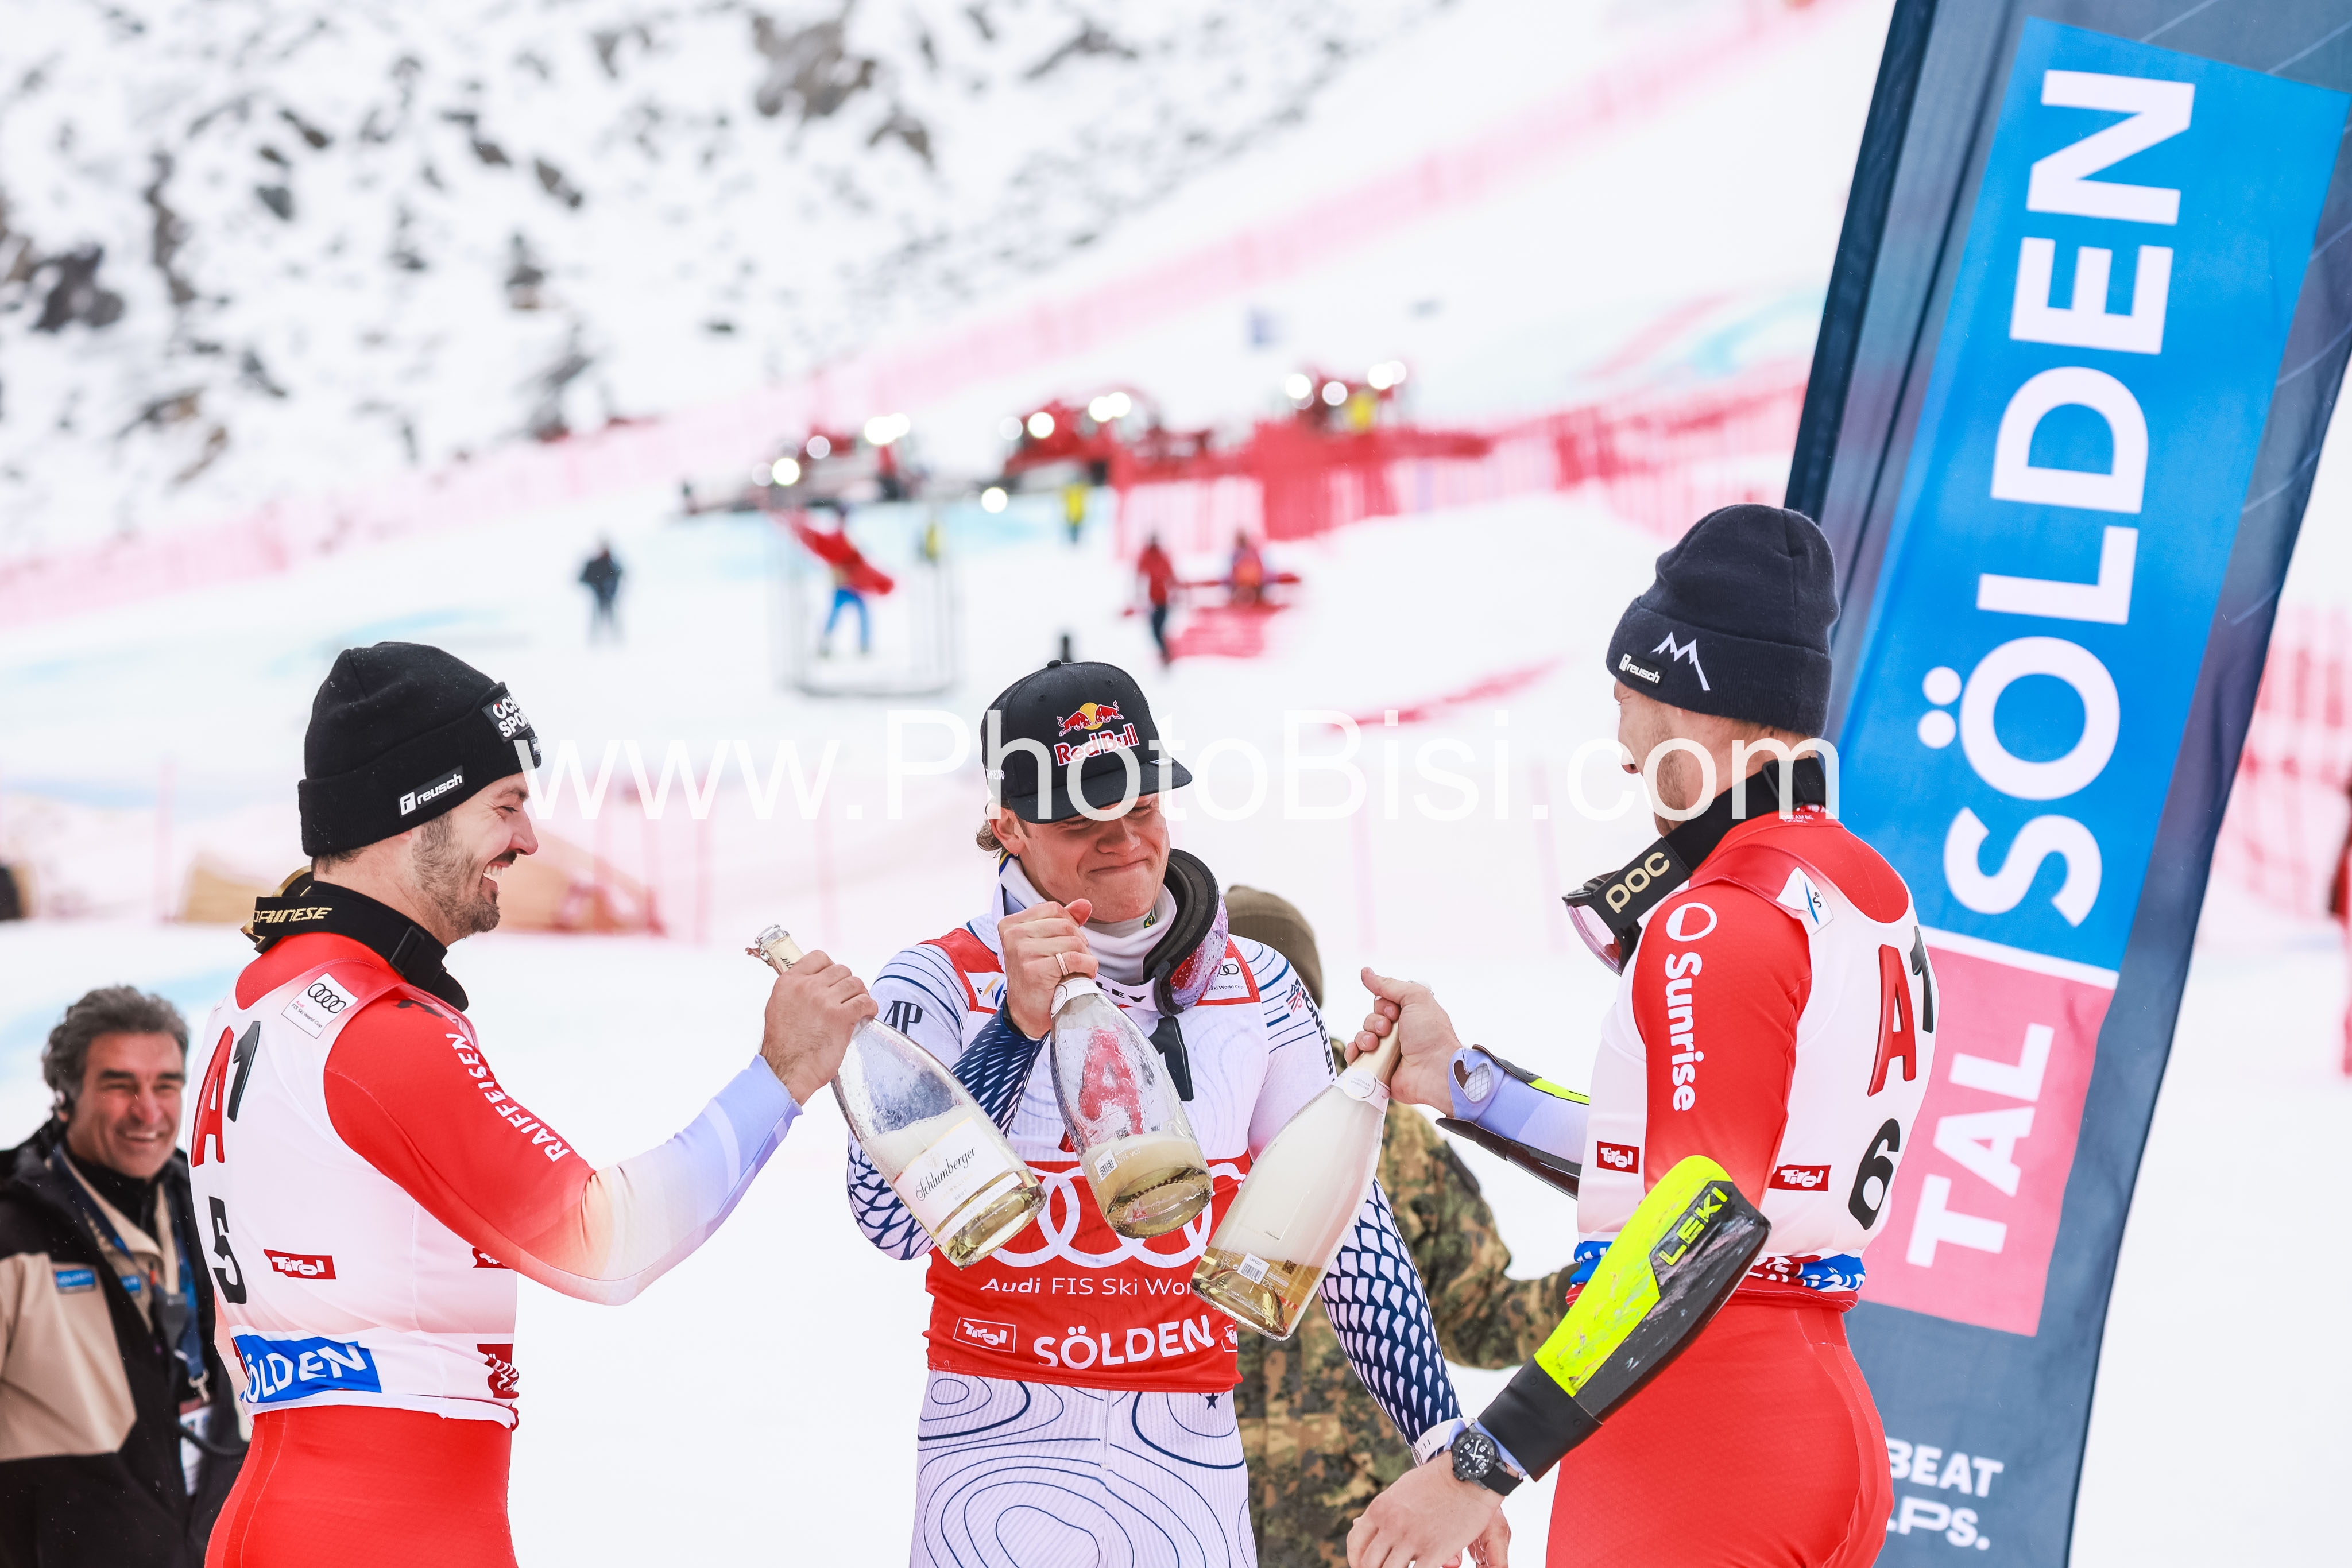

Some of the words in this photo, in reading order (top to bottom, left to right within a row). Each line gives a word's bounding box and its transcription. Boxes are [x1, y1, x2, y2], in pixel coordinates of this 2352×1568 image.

[1918, 69, 2196, 927] SÖLDEN
[1626, 663, 1661, 684] reusch
[1054, 733, 1100, 766] Red
[1100, 723, 1139, 753] Bull
[417, 773, 462, 804] reusch
[304, 1013, 315, 1023] World
[314, 1020, 323, 1028] Cup
[1665, 951, 1705, 1112] Sunrise
[1867, 926, 1933, 1097] A1
[191, 1021, 260, 1167] A1
[446, 1033, 570, 1162] RAIFFEISEN
[1129, 1148, 1141, 1157] vol
[1601, 1148, 1633, 1168] Tirol
[1906, 1022, 2054, 1268] TAL
[916, 1147, 976, 1201] Schlumberger
[1780, 1169, 1824, 1187] Tirol
[1848, 1118, 1901, 1230] 6
[209, 1196, 246, 1304] 5
[1658, 1187, 1728, 1266] LEKI
[272, 1256, 325, 1276] Tirol
[980, 1277, 1041, 1294] Audi
[1052, 1277, 1094, 1295] FIS
[1101, 1277, 1138, 1295] Ski
[1144, 1277, 1190, 1295] Wor
[963, 1321, 1007, 1345] Tirol
[1034, 1314, 1215, 1370] SÖLDEN
[243, 1344, 368, 1403] ÖLDEN
[1885, 1436, 2004, 1497] BEAT
[1886, 1496, 1990, 1550] PS.
